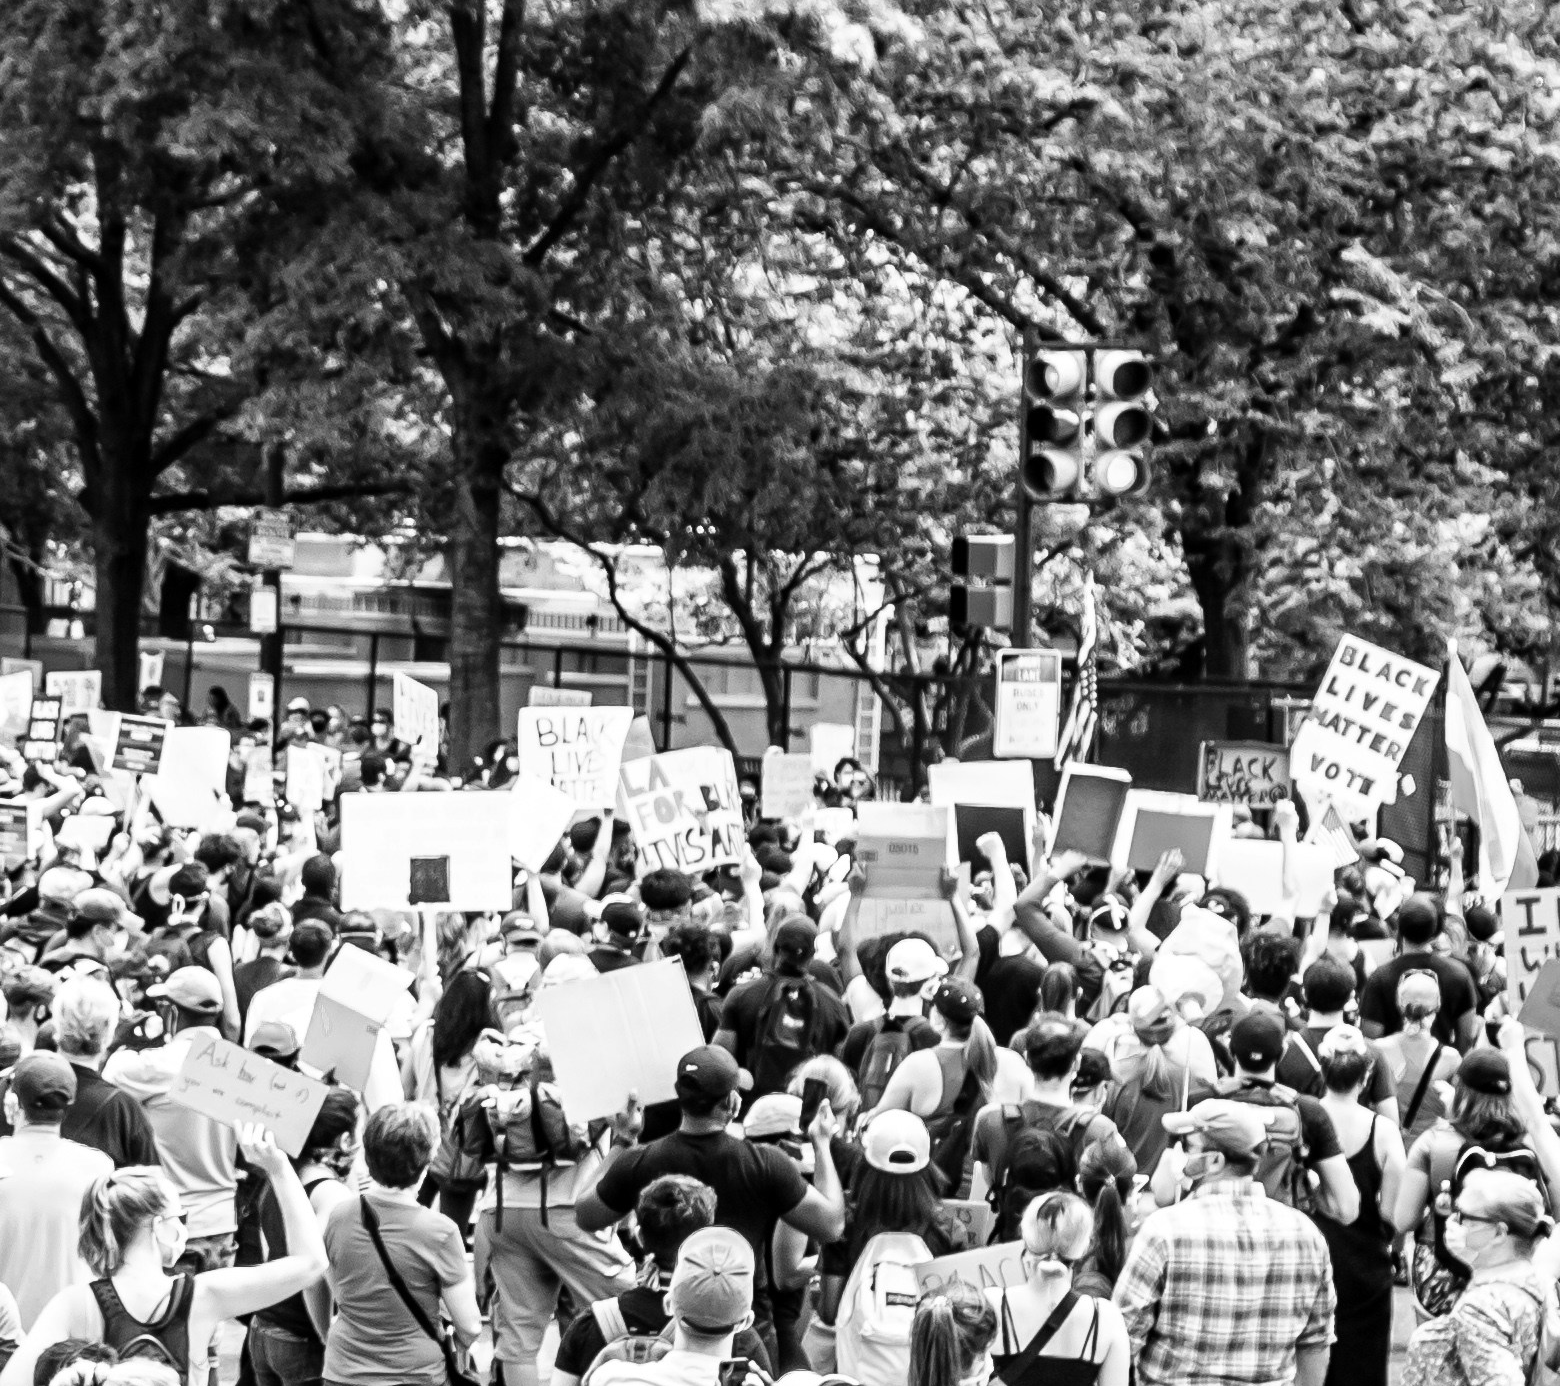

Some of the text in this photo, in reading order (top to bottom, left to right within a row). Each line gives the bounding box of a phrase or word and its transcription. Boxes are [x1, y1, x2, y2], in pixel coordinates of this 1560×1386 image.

[1340, 644, 1430, 697] BLACK
[1326, 675, 1416, 730] LIVES
[536, 716, 616, 747] BLACK
[1314, 705, 1403, 762] MATTER
[1310, 752, 1376, 796] VOTE
[1516, 897, 1547, 936] I
[196, 1041, 230, 1068] Ask
